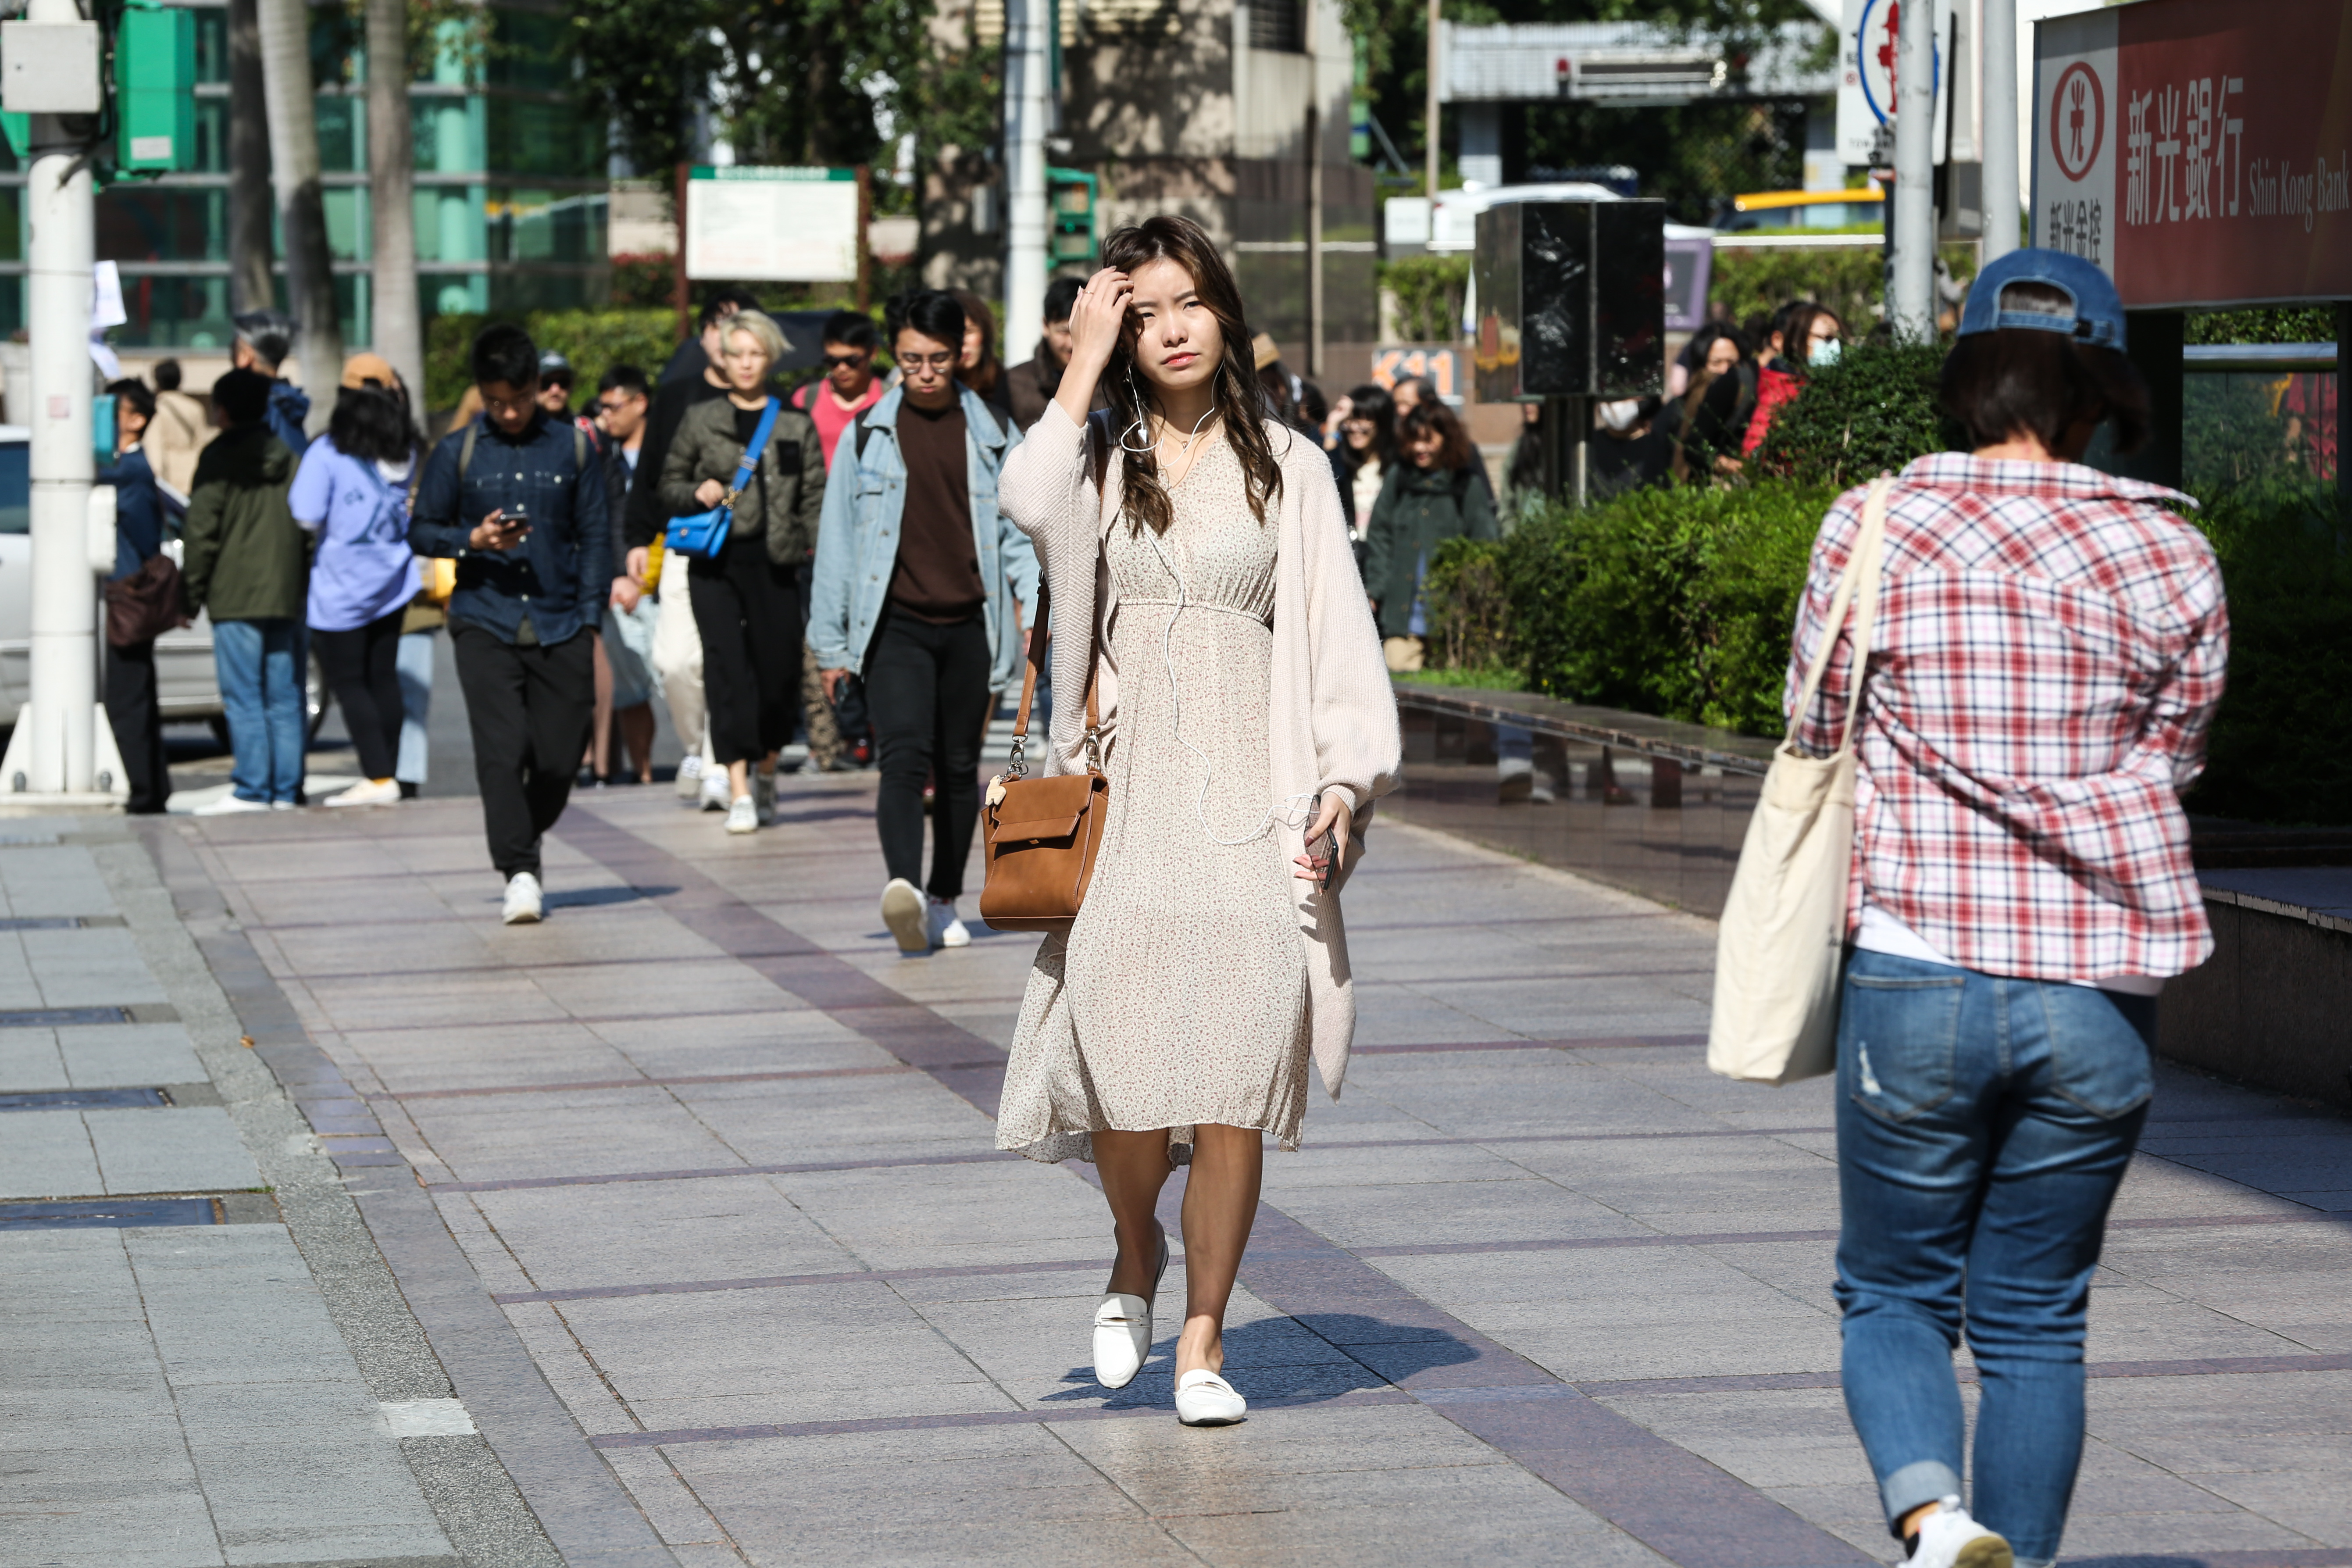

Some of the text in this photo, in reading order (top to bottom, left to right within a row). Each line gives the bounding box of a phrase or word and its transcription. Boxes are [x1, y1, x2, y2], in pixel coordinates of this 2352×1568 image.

[2126, 75, 2243, 226] 新光銀行
[2249, 150, 2349, 233] Shin Kong Bank
